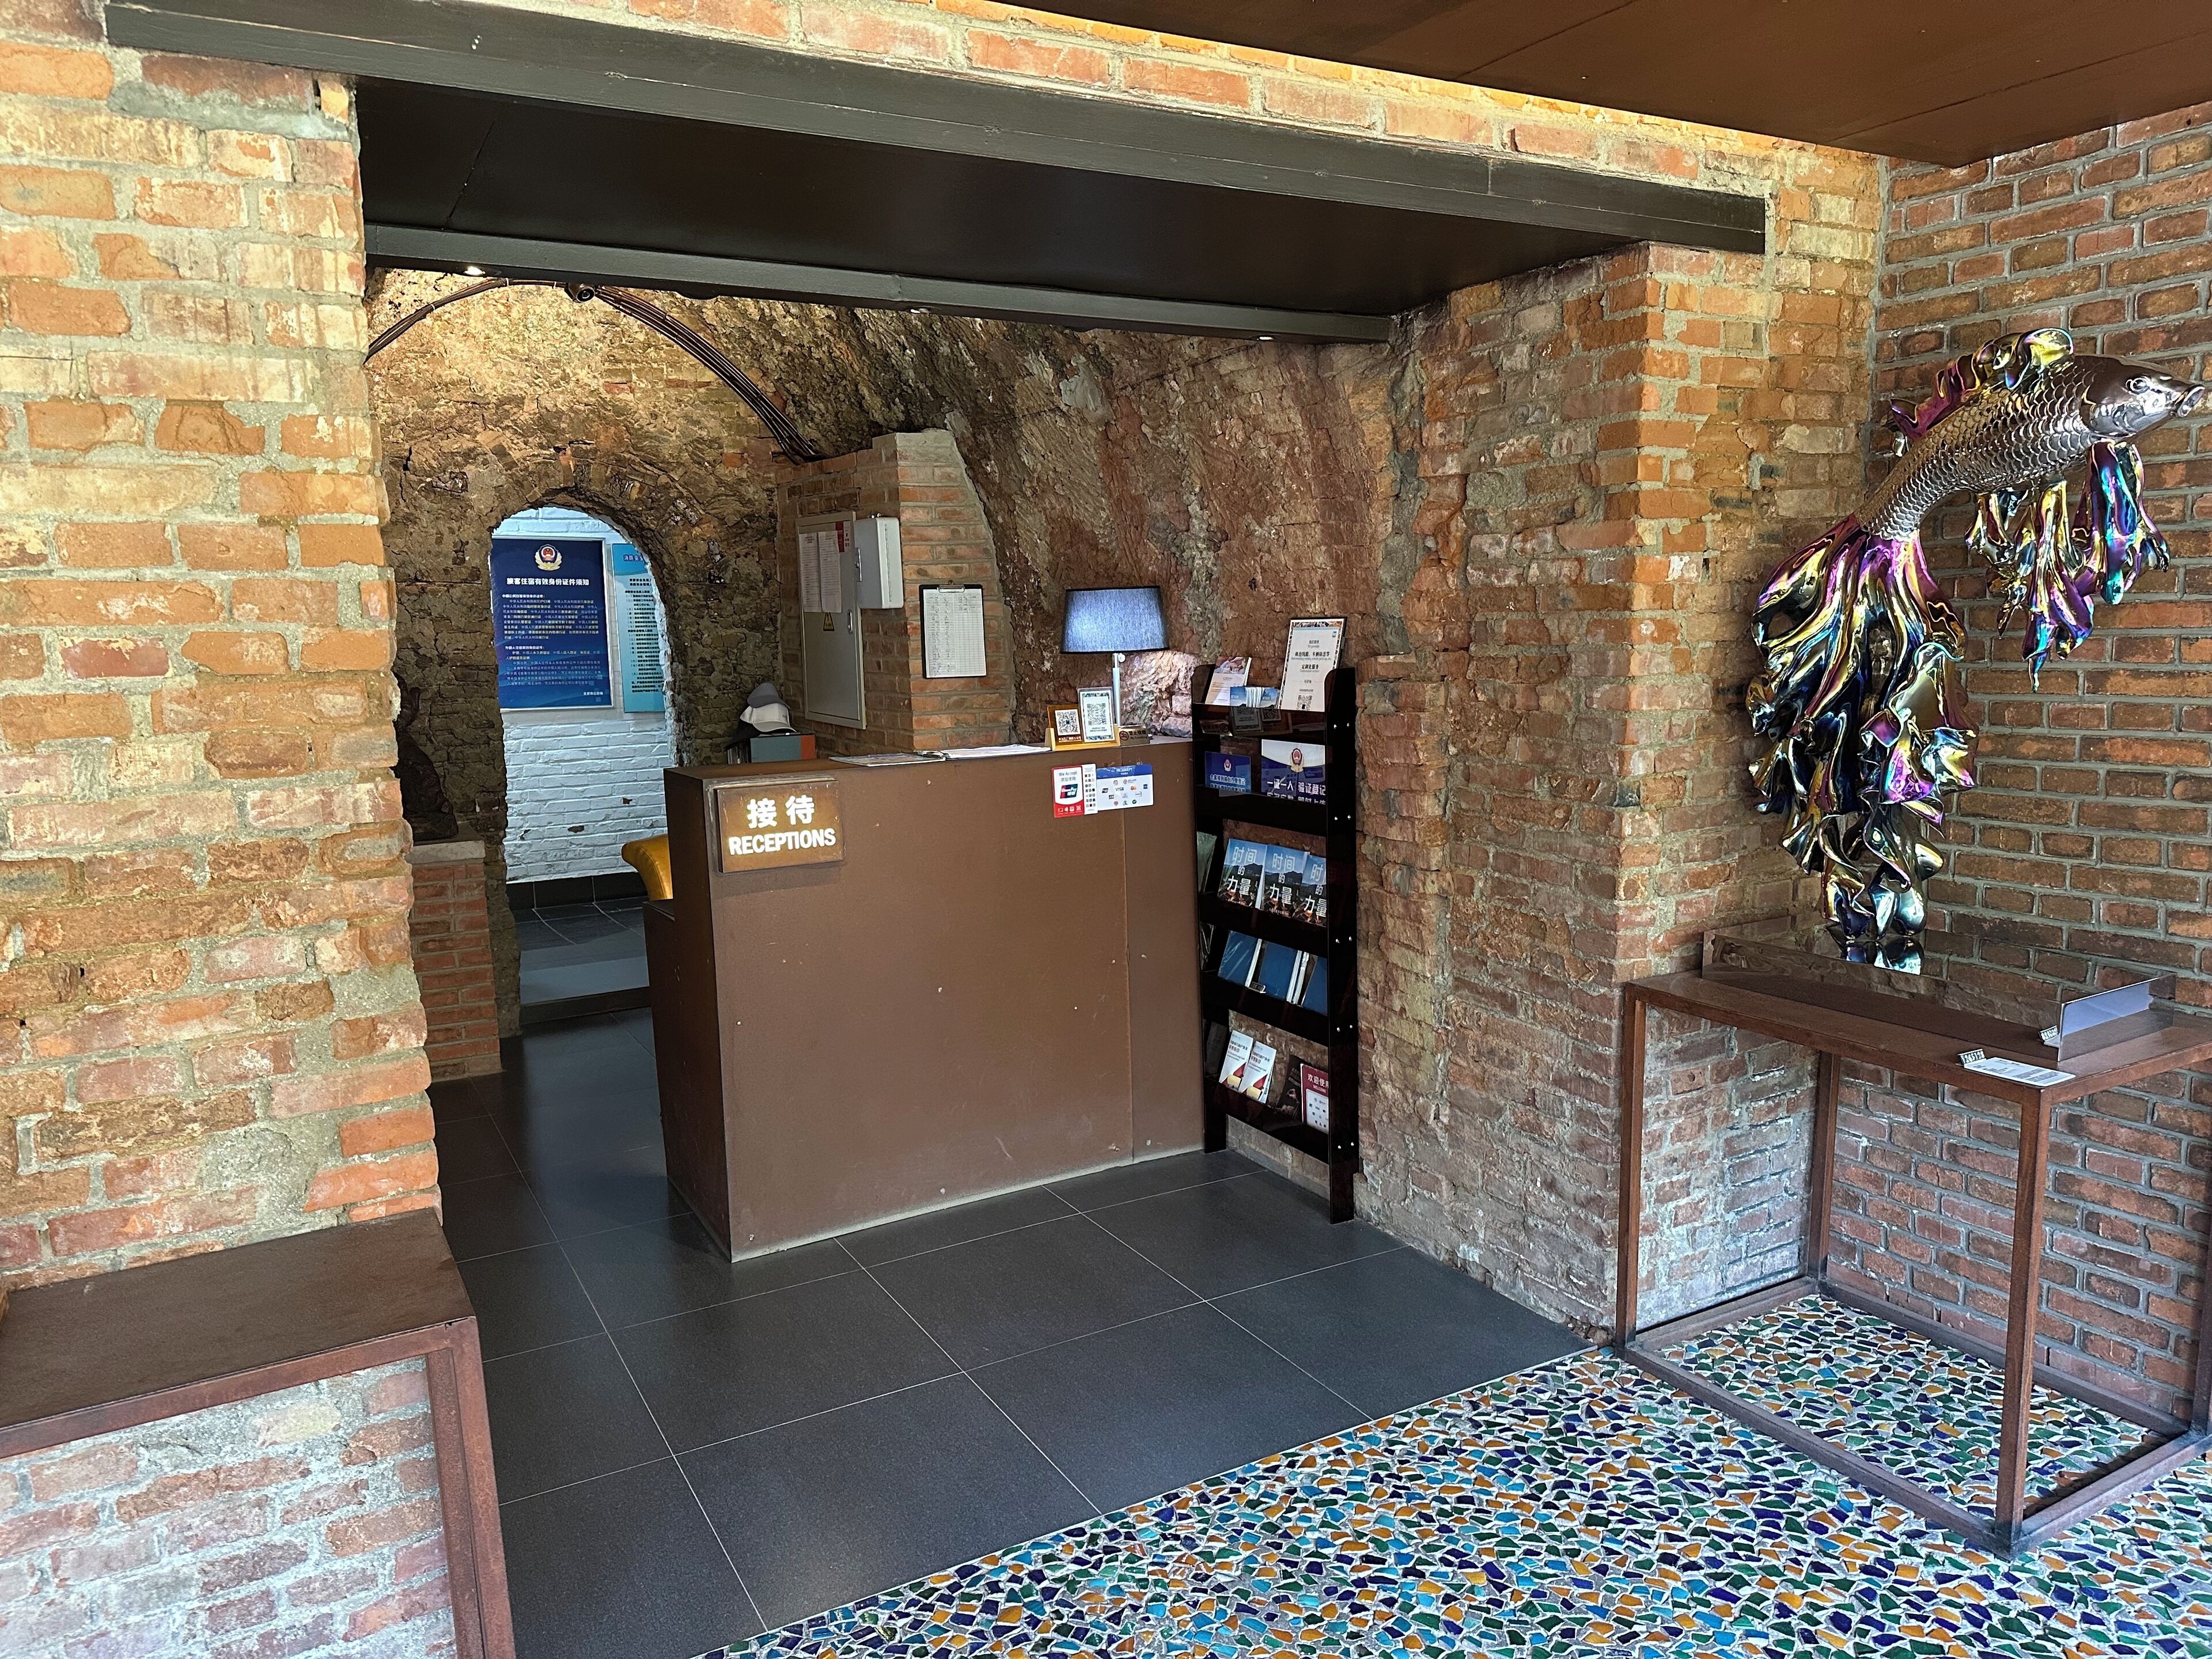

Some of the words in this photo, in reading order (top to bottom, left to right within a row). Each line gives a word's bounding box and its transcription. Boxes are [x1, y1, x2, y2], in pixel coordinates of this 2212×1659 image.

[506, 578, 589, 586] 旅客住宿有效身份证件须知
[1267, 779, 1294, 791] 一证一人
[1298, 782, 1325, 796] 验证登记
[747, 794, 815, 829] 接待
[729, 828, 836, 855] RECEPTIONS
[1232, 846, 1257, 863] 时间
[1272, 853, 1296, 871] 时间
[1237, 866, 1245, 876] 的
[1278, 873, 1285, 884] 的
[1310, 864, 1326, 882] 时
[1227, 876, 1251, 896] 力量
[1270, 883, 1293, 904] 力量
[1315, 884, 1323, 895] 的
[1304, 895, 1327, 917] 力量
